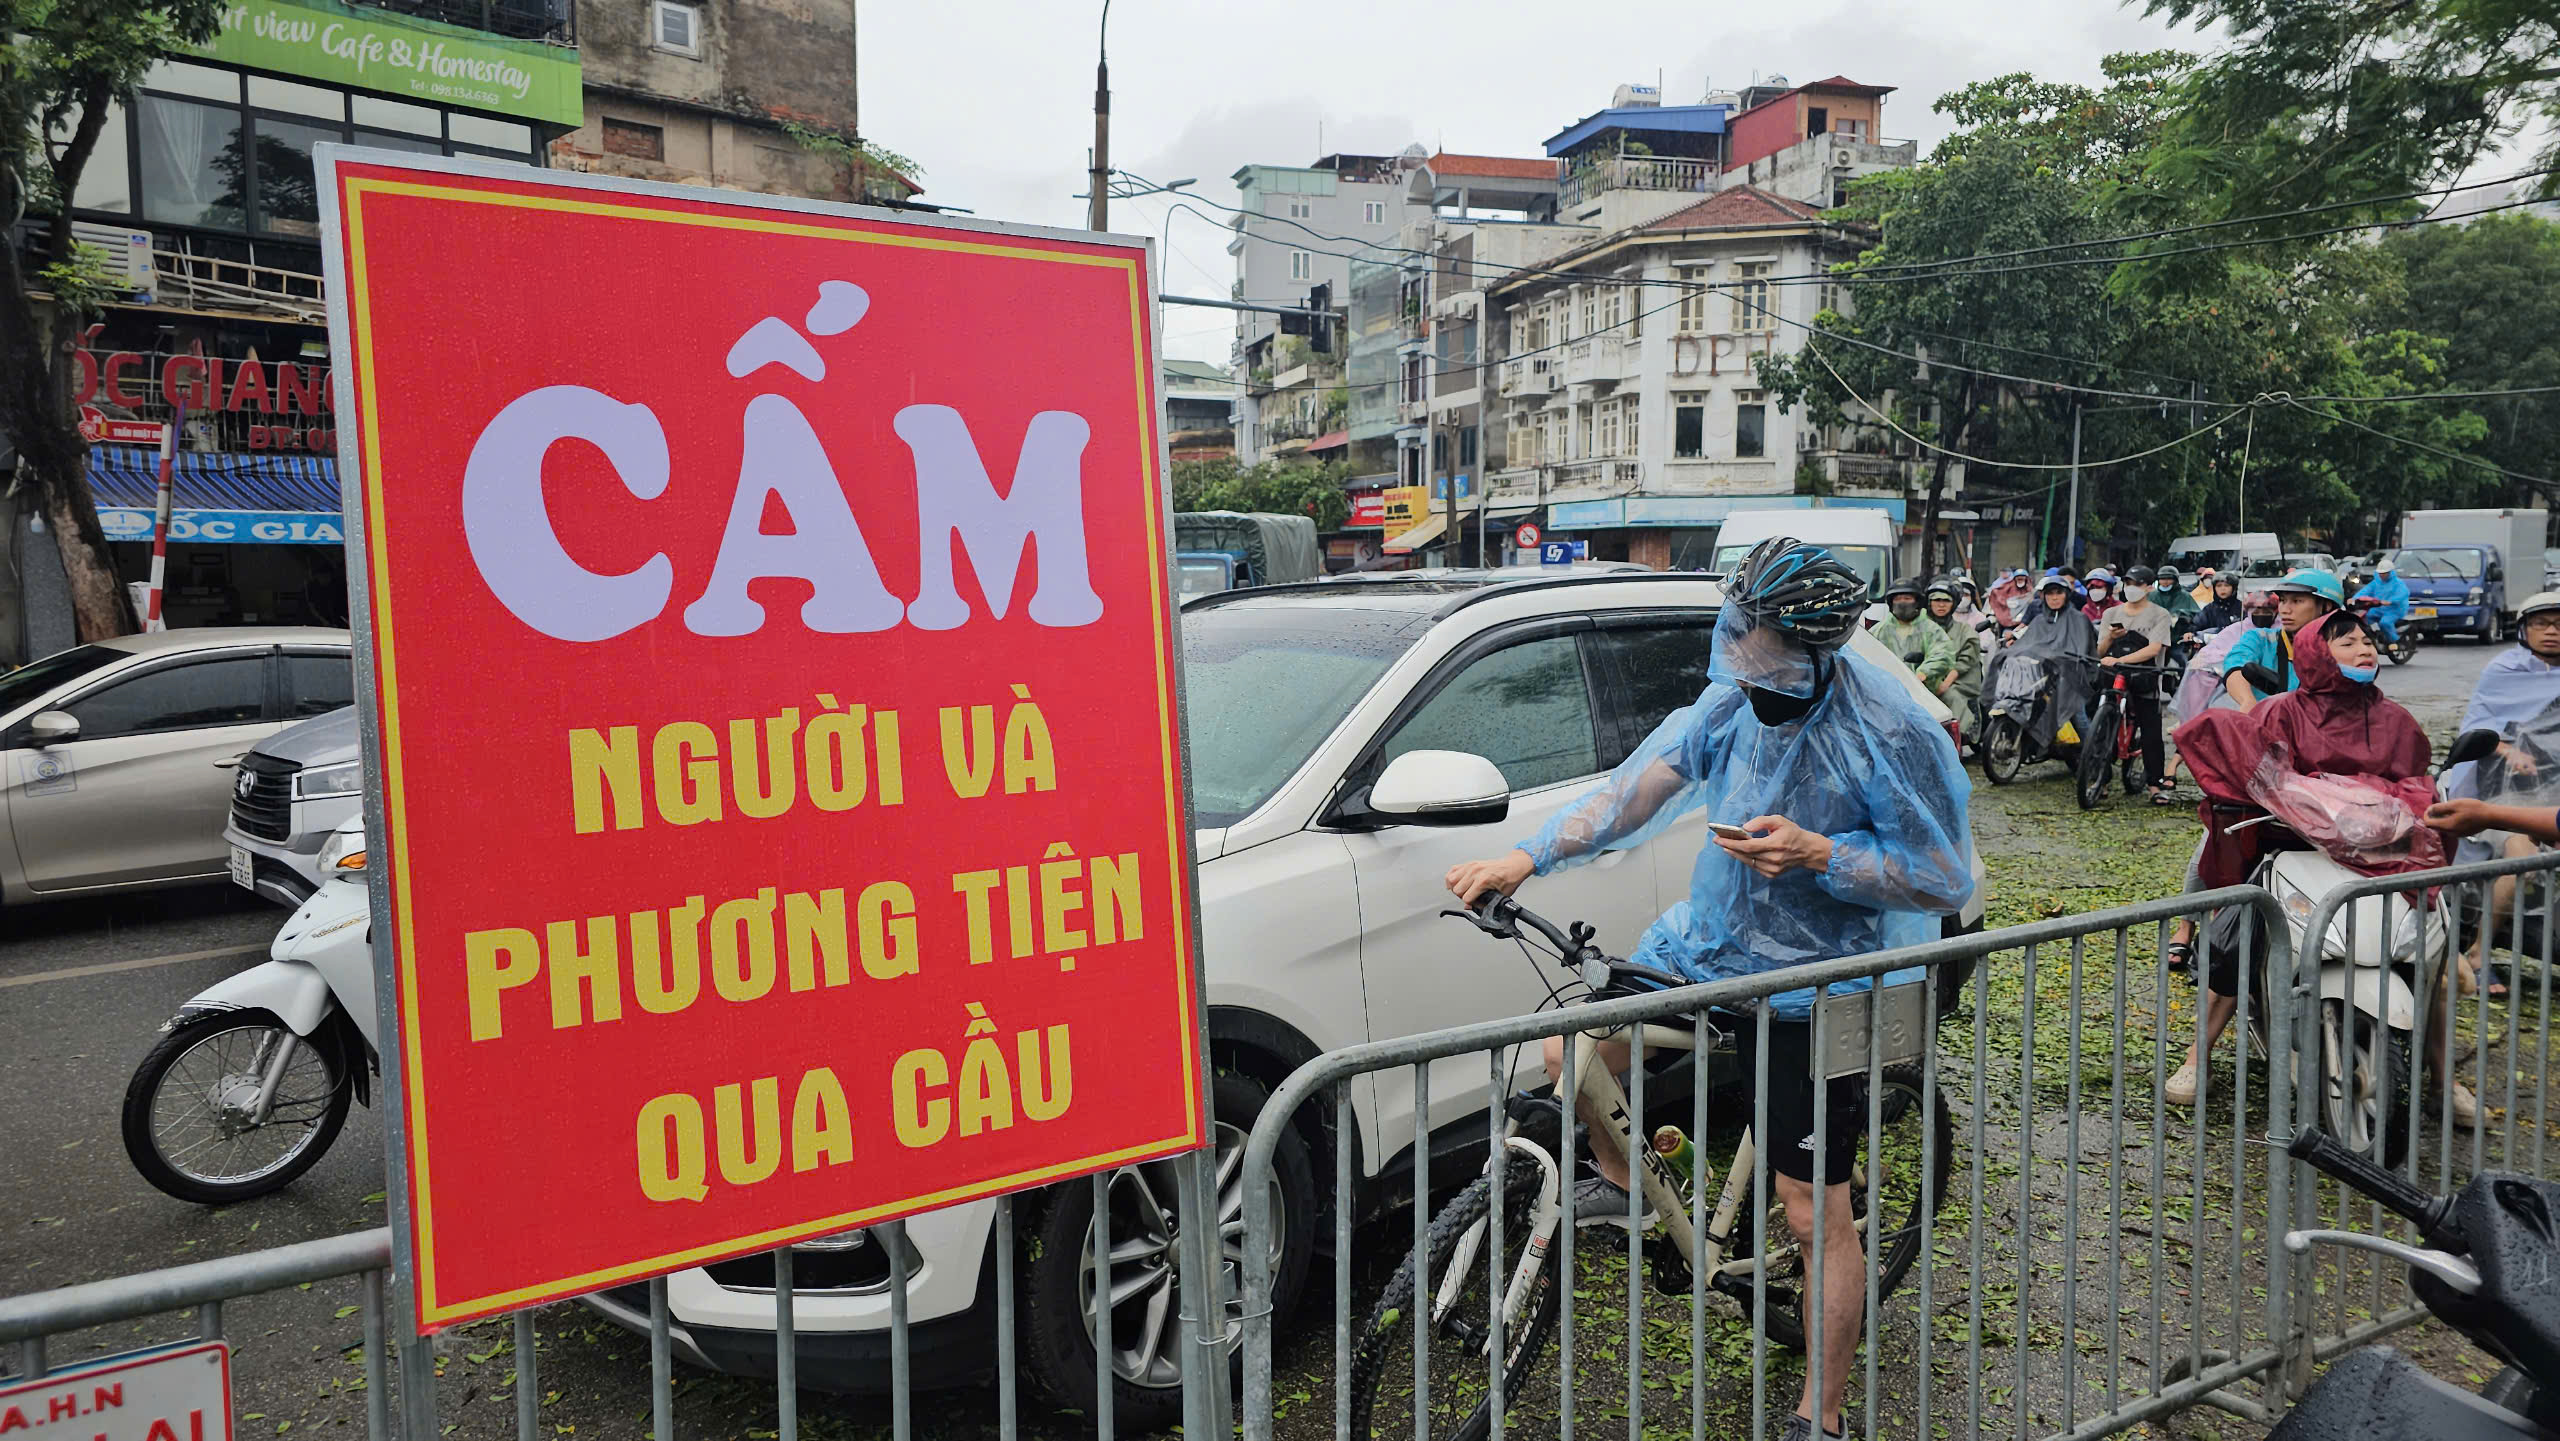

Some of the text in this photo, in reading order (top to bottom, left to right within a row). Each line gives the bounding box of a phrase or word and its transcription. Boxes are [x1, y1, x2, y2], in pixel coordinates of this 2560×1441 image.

[254, 11, 315, 43] view
[321, 24, 383, 73] Cafe
[388, 39, 414, 67] &
[416, 43, 531, 100] Homestay
[162, 354, 334, 415] GIAN
[463, 280, 1104, 642] CẤM
[168, 513, 235, 539] ỐC
[1546, 544, 1564, 562] G7
[569, 684, 1057, 834] NGƯỜI VÀ
[464, 842, 1144, 1042] PHƯƠNG TIỆN
[636, 1001, 1074, 1203] QUA CẦU
